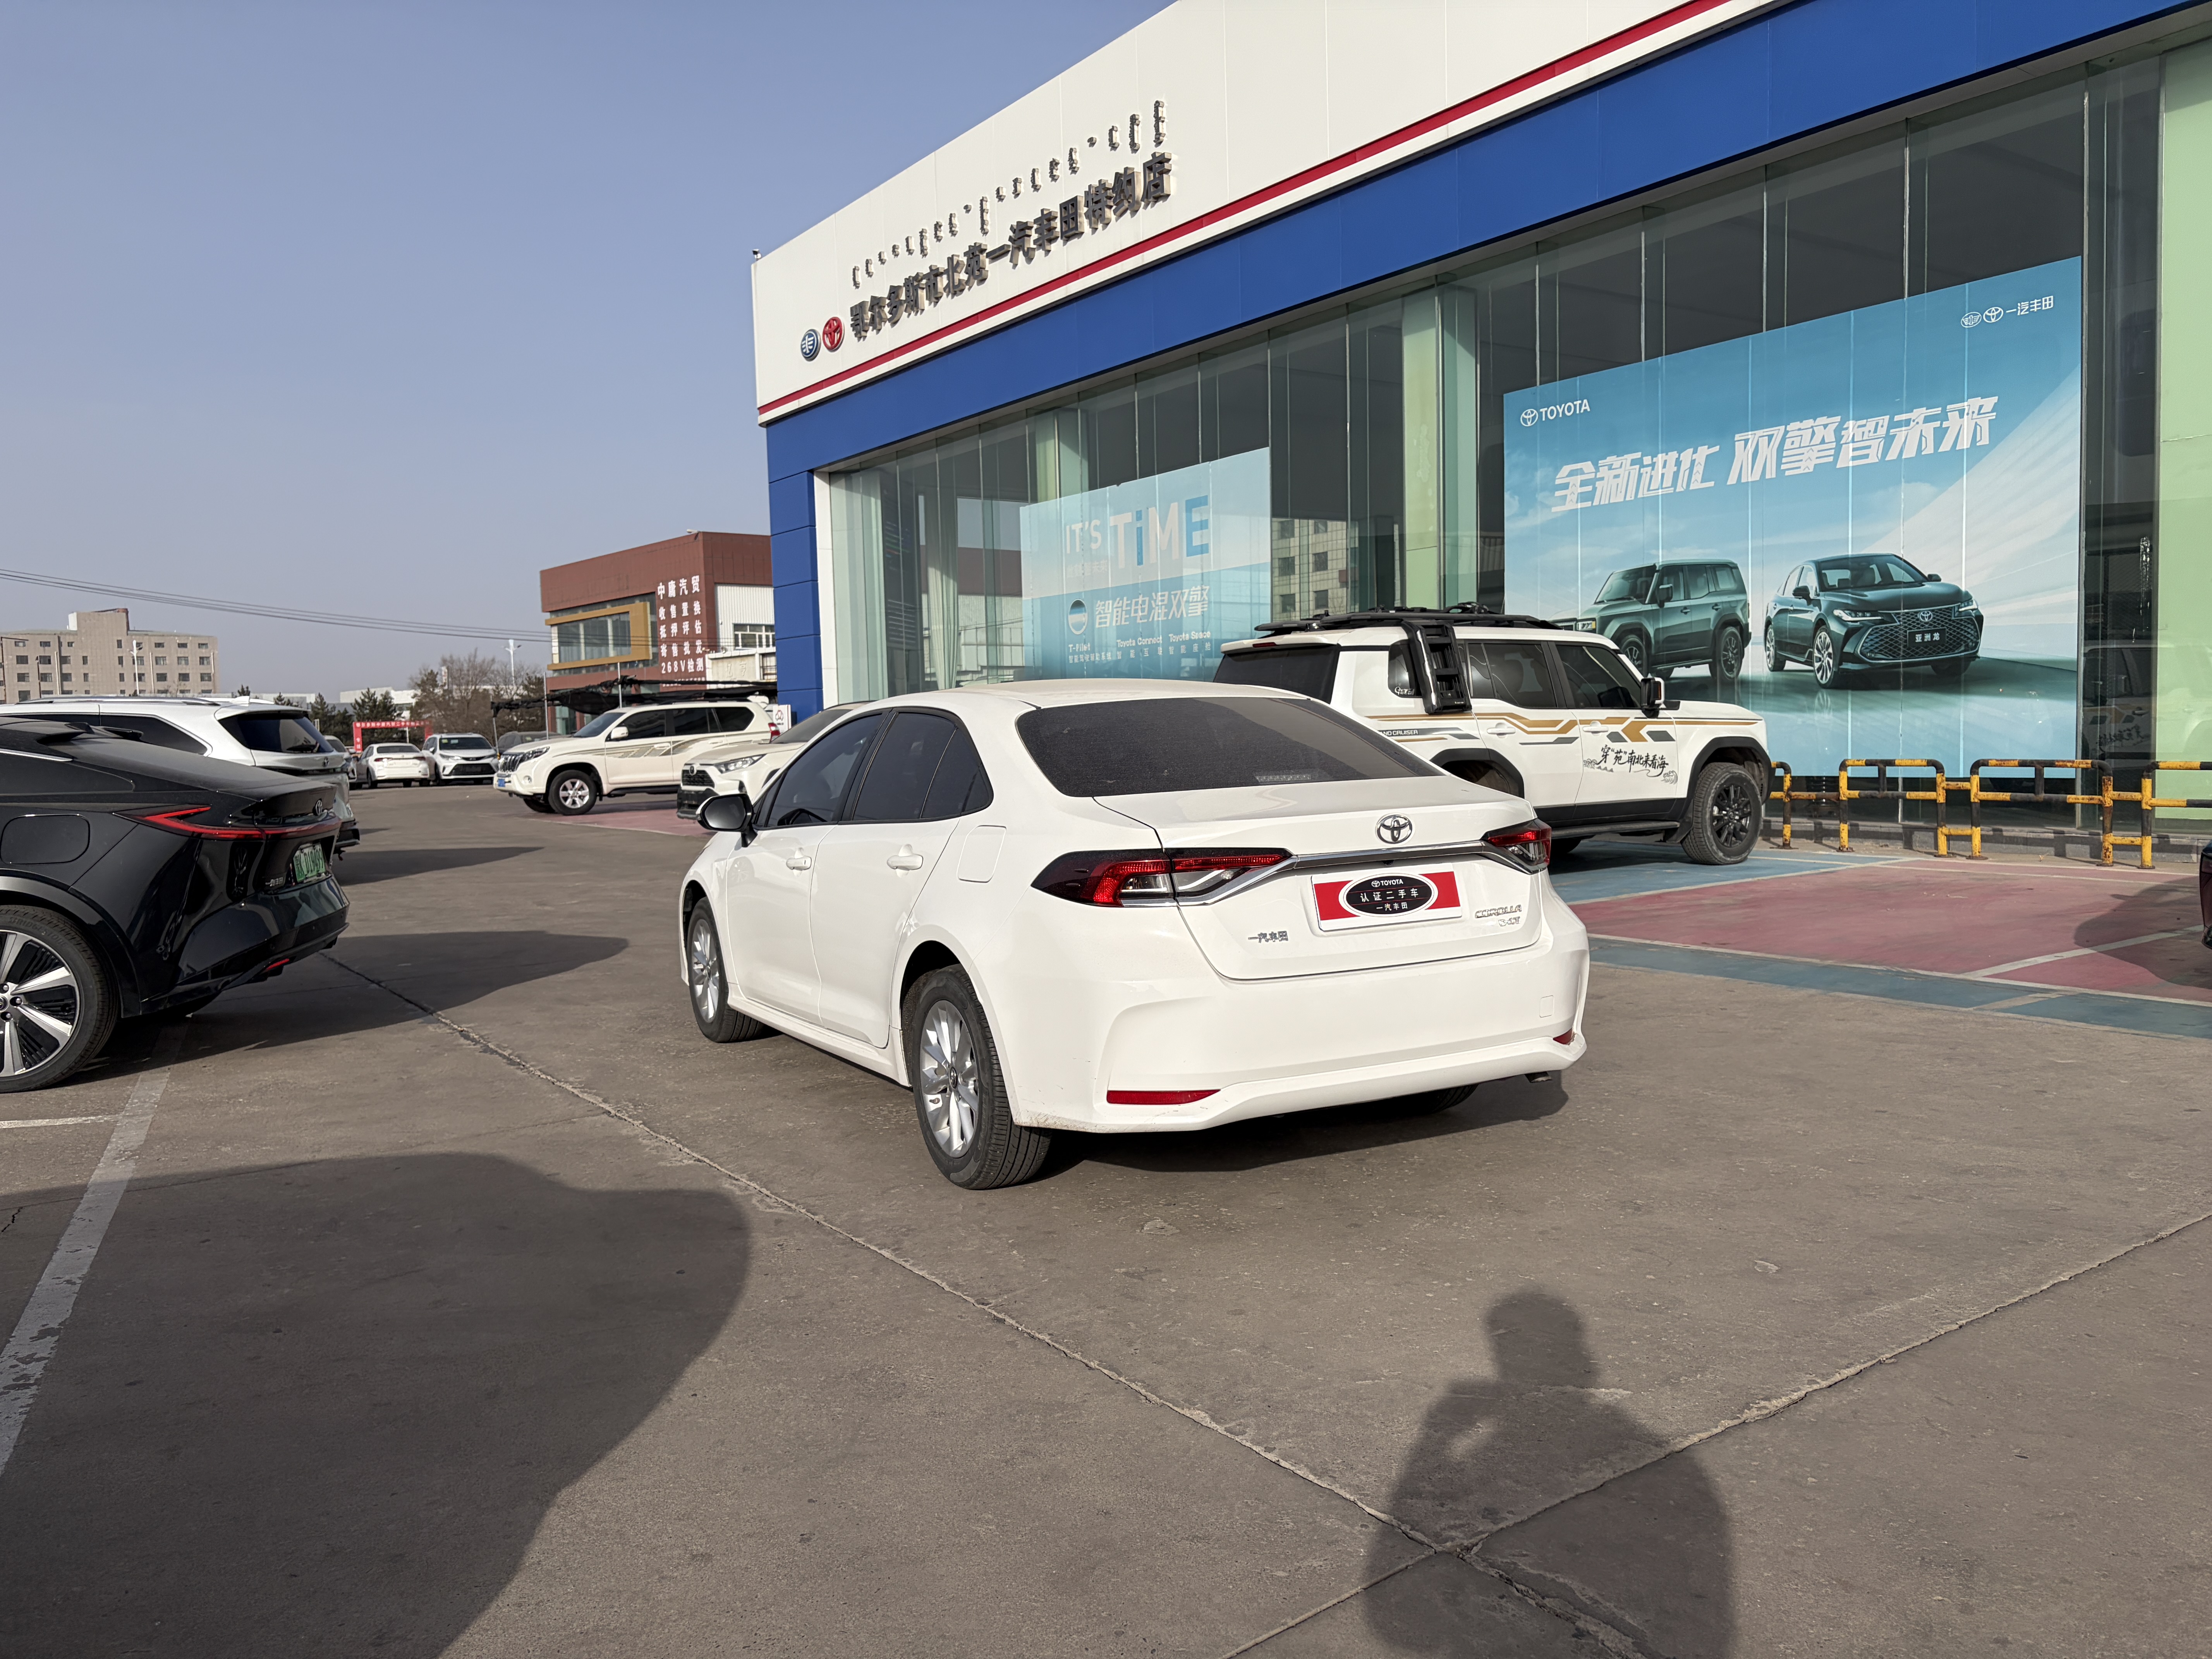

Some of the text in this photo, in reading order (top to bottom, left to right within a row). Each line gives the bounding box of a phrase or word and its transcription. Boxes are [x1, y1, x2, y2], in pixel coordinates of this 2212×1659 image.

[850, 152, 1172, 338] 鄂尔多斯市北苑一汽丰田特约店
[2006, 295, 2054, 316] 一汽丰田
[1540, 399, 1590, 421] TOYOTA
[1551, 396, 1999, 512] 全新进化 双擎智未来
[1066, 519, 1102, 554] IT'S
[1096, 585, 1210, 628] 智能电混双擎
[1116, 638, 1136, 648] Toyota
[1168, 630, 1211, 642] Toyota Space
[1915, 632, 1940, 642] 亚洲龙
[1360, 888, 1419, 903] 认证二手车
[1376, 902, 1408, 911] 一汽丰田
[1475, 904, 1522, 919] COROLLA
[1248, 930, 1289, 943] 一汽丰田
